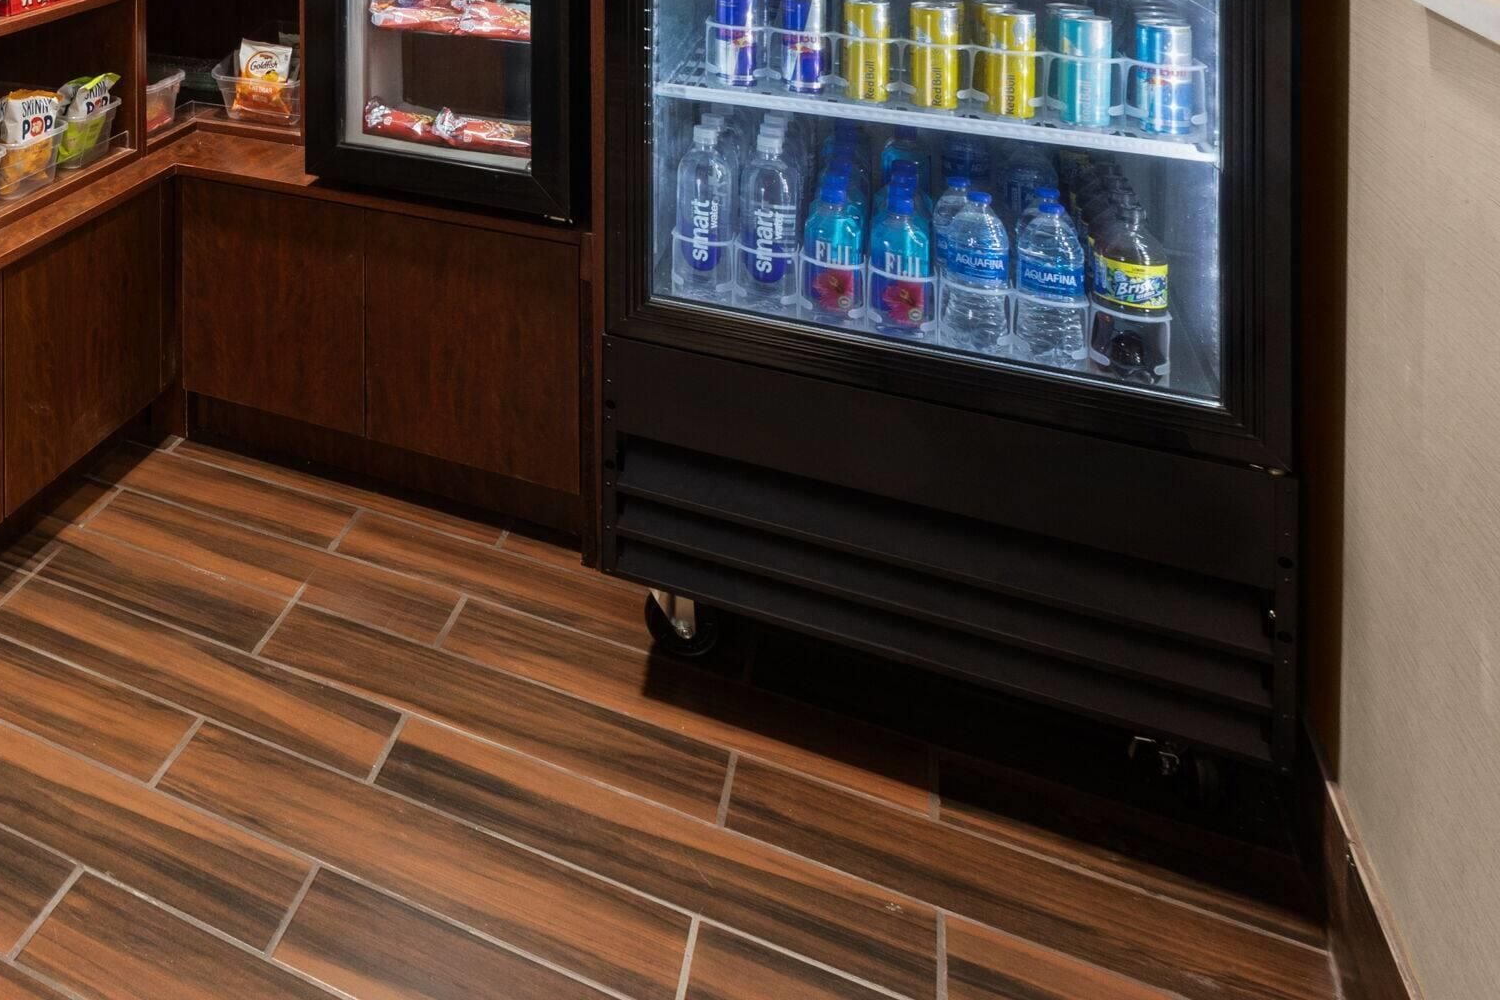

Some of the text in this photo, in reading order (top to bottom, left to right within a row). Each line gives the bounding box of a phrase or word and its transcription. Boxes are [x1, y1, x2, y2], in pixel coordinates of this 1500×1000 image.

[251, 58, 278, 73] Goldfish
[866, 60, 875, 100] Red Bull
[932, 67, 942, 107] Red Bull
[1005, 96, 1015, 115] Red
[22, 115, 54, 141] POP
[710, 200, 719, 229] water
[774, 212, 784, 240] water
[692, 199, 710, 262] smart
[754, 208, 773, 274] smart
[815, 241, 850, 266] FIJI
[885, 252, 921, 278] FIJI
[955, 253, 1005, 271] AQUAFINA
[1024, 268, 1077, 287] AQUAFINA
[1116, 277, 1155, 296] Brisk
